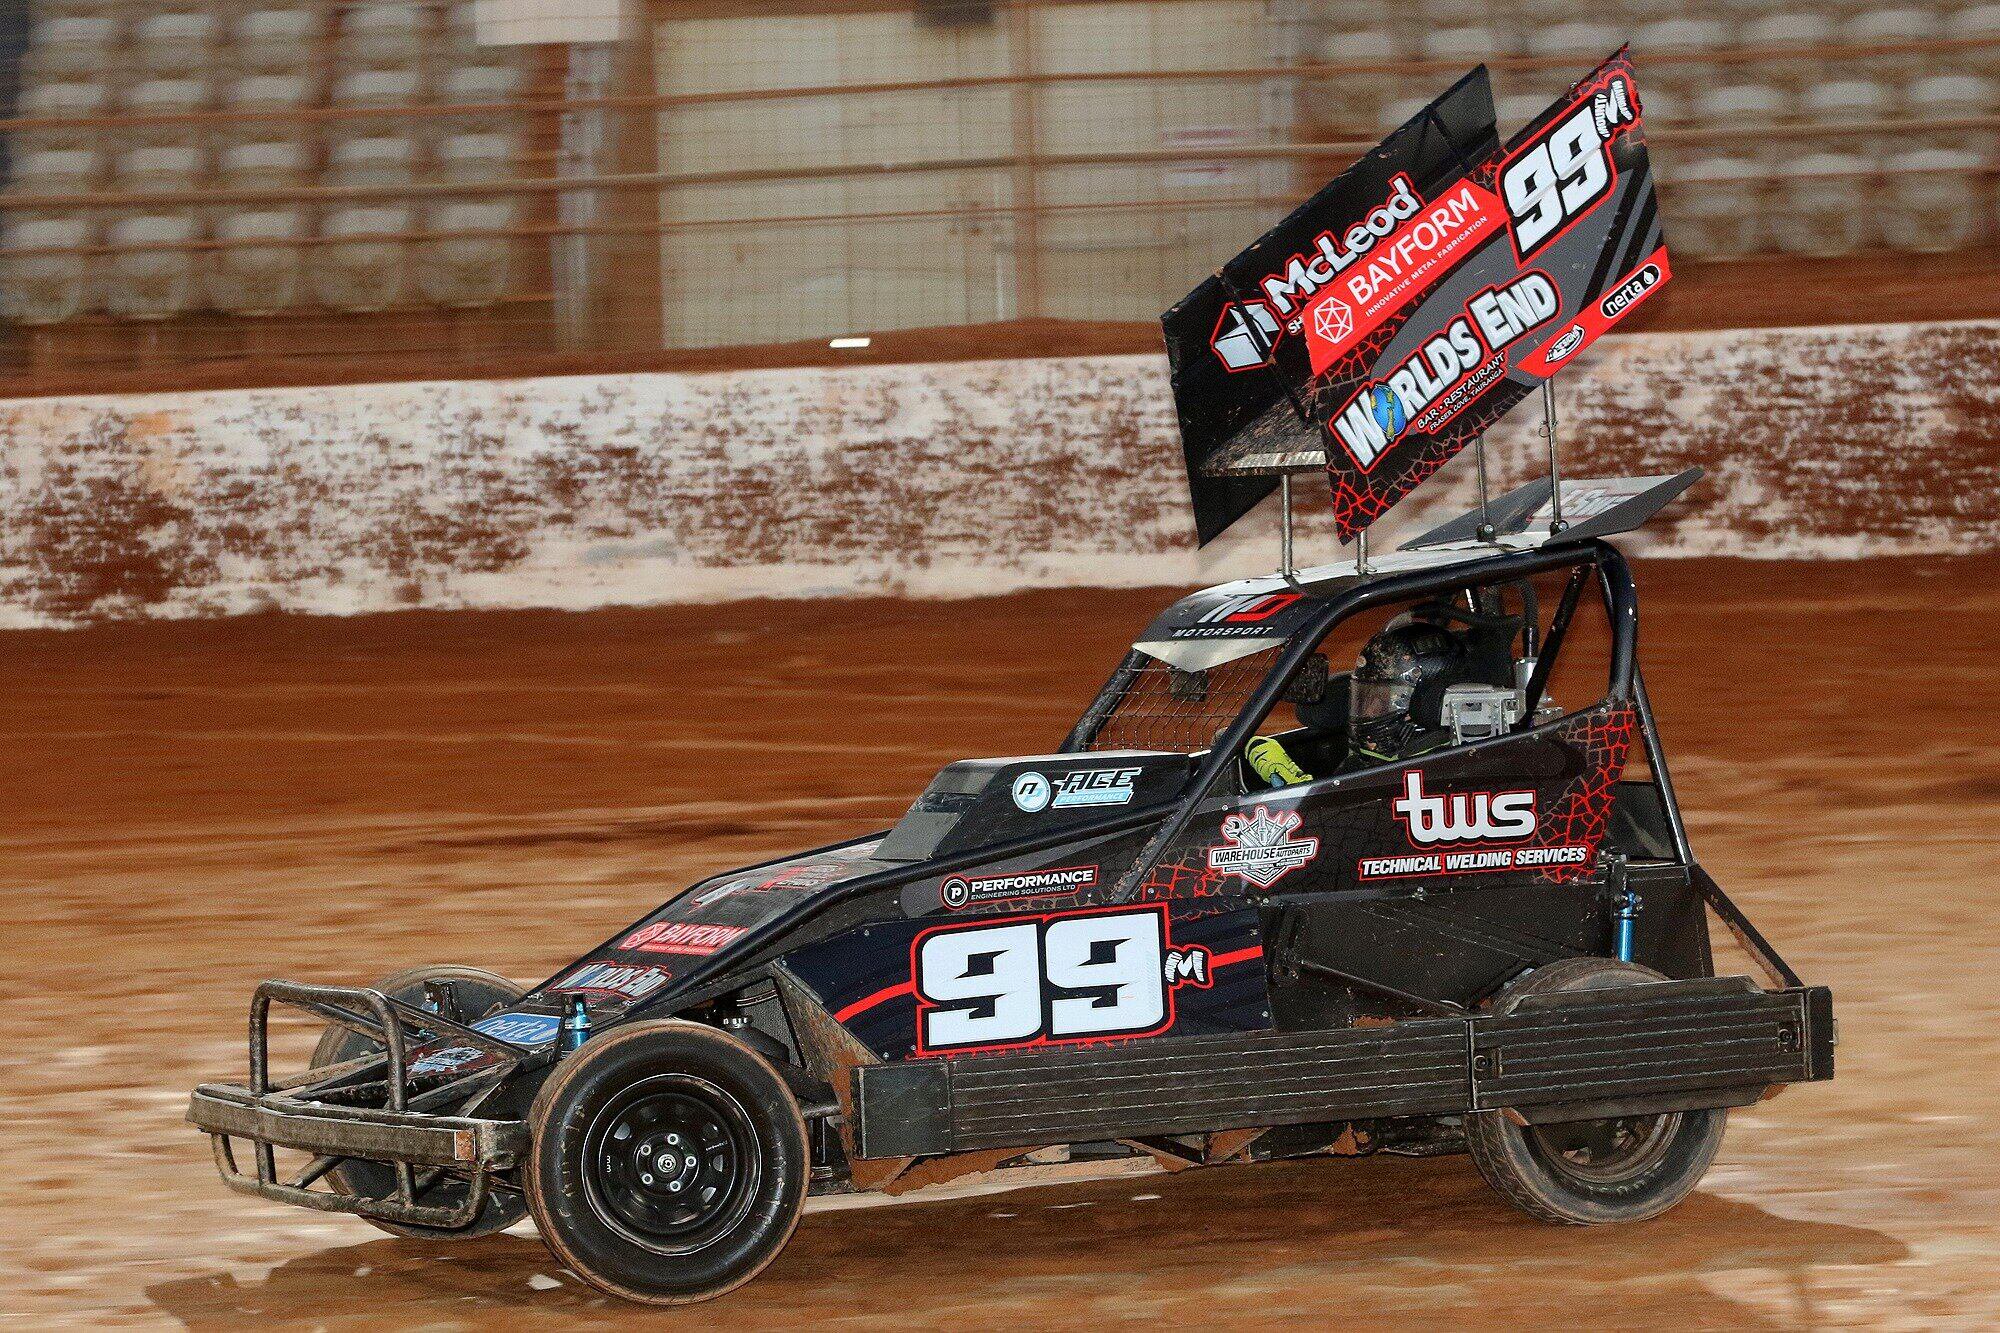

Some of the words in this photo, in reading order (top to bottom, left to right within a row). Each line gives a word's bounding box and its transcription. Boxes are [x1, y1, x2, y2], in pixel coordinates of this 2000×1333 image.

[1264, 177, 1421, 314] McLeod
[1348, 187, 1480, 305] BAYFORM
[1365, 280, 1411, 317] INNOVATIVE
[1411, 258, 1438, 280] METAL
[1437, 215, 1488, 259] FABRICATION
[1468, 273, 1559, 350] END
[1605, 280, 1647, 314] nerta
[1417, 408, 1440, 429] BAR
[1443, 352, 1505, 407] RESTAURANT
[1429, 409, 1454, 431] FRASER
[1470, 368, 1504, 396] TAURANGA
[1171, 626, 1274, 638] MOTORSPORT
[1053, 767, 1142, 794] ACE
[1215, 847, 1277, 863] WAREHOUSE
[1276, 846, 1311, 858] AUTOPARTS
[1362, 854, 1442, 876] TECHNICAL
[1446, 850, 1512, 870] WELDING
[1515, 847, 1587, 866] SERVICES
[970, 889, 1021, 900] ENGINEERING
[1020, 885, 1062, 896] SOLUTIONS
[971, 869, 1094, 893] PERFORMANCE
[653, 923, 748, 948] BAYFORM
